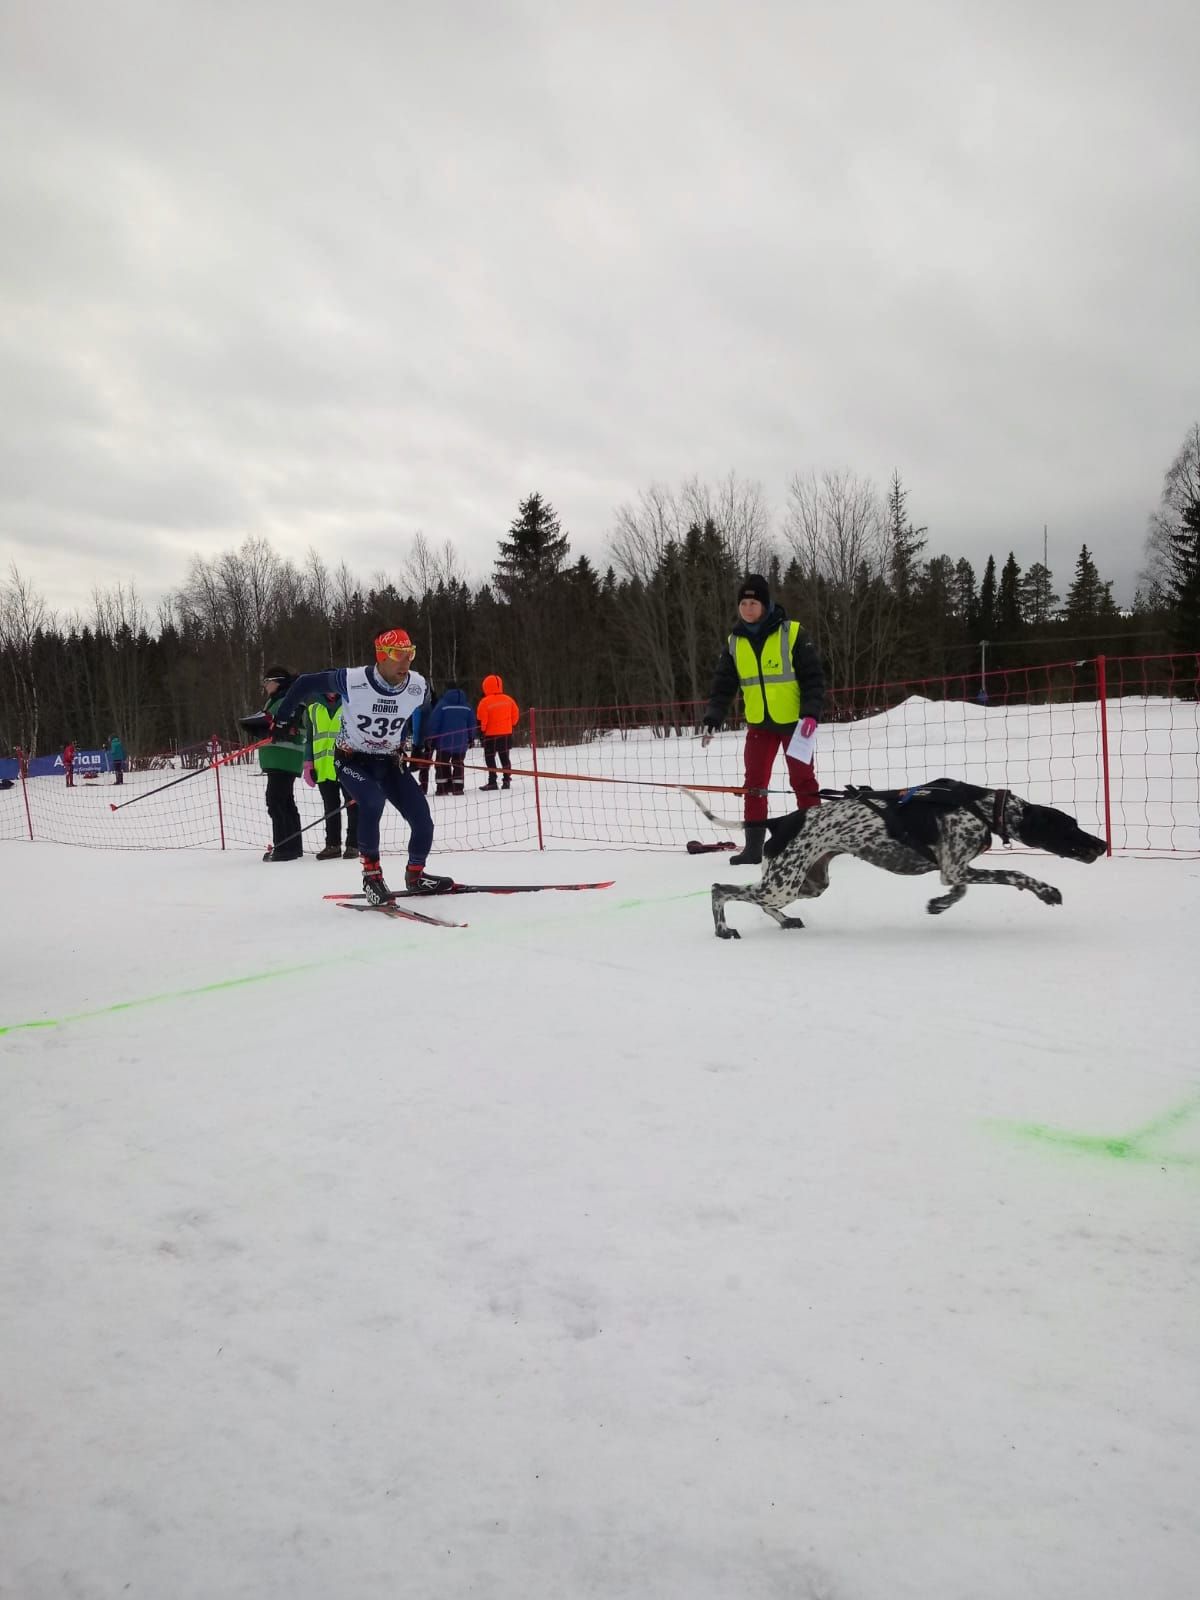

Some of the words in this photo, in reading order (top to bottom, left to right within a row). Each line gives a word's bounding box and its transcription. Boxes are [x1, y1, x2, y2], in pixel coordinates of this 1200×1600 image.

[372, 704, 399, 713] ROBUR
[357, 714, 405, 738] 239
[53, 753, 90, 768] Aria
